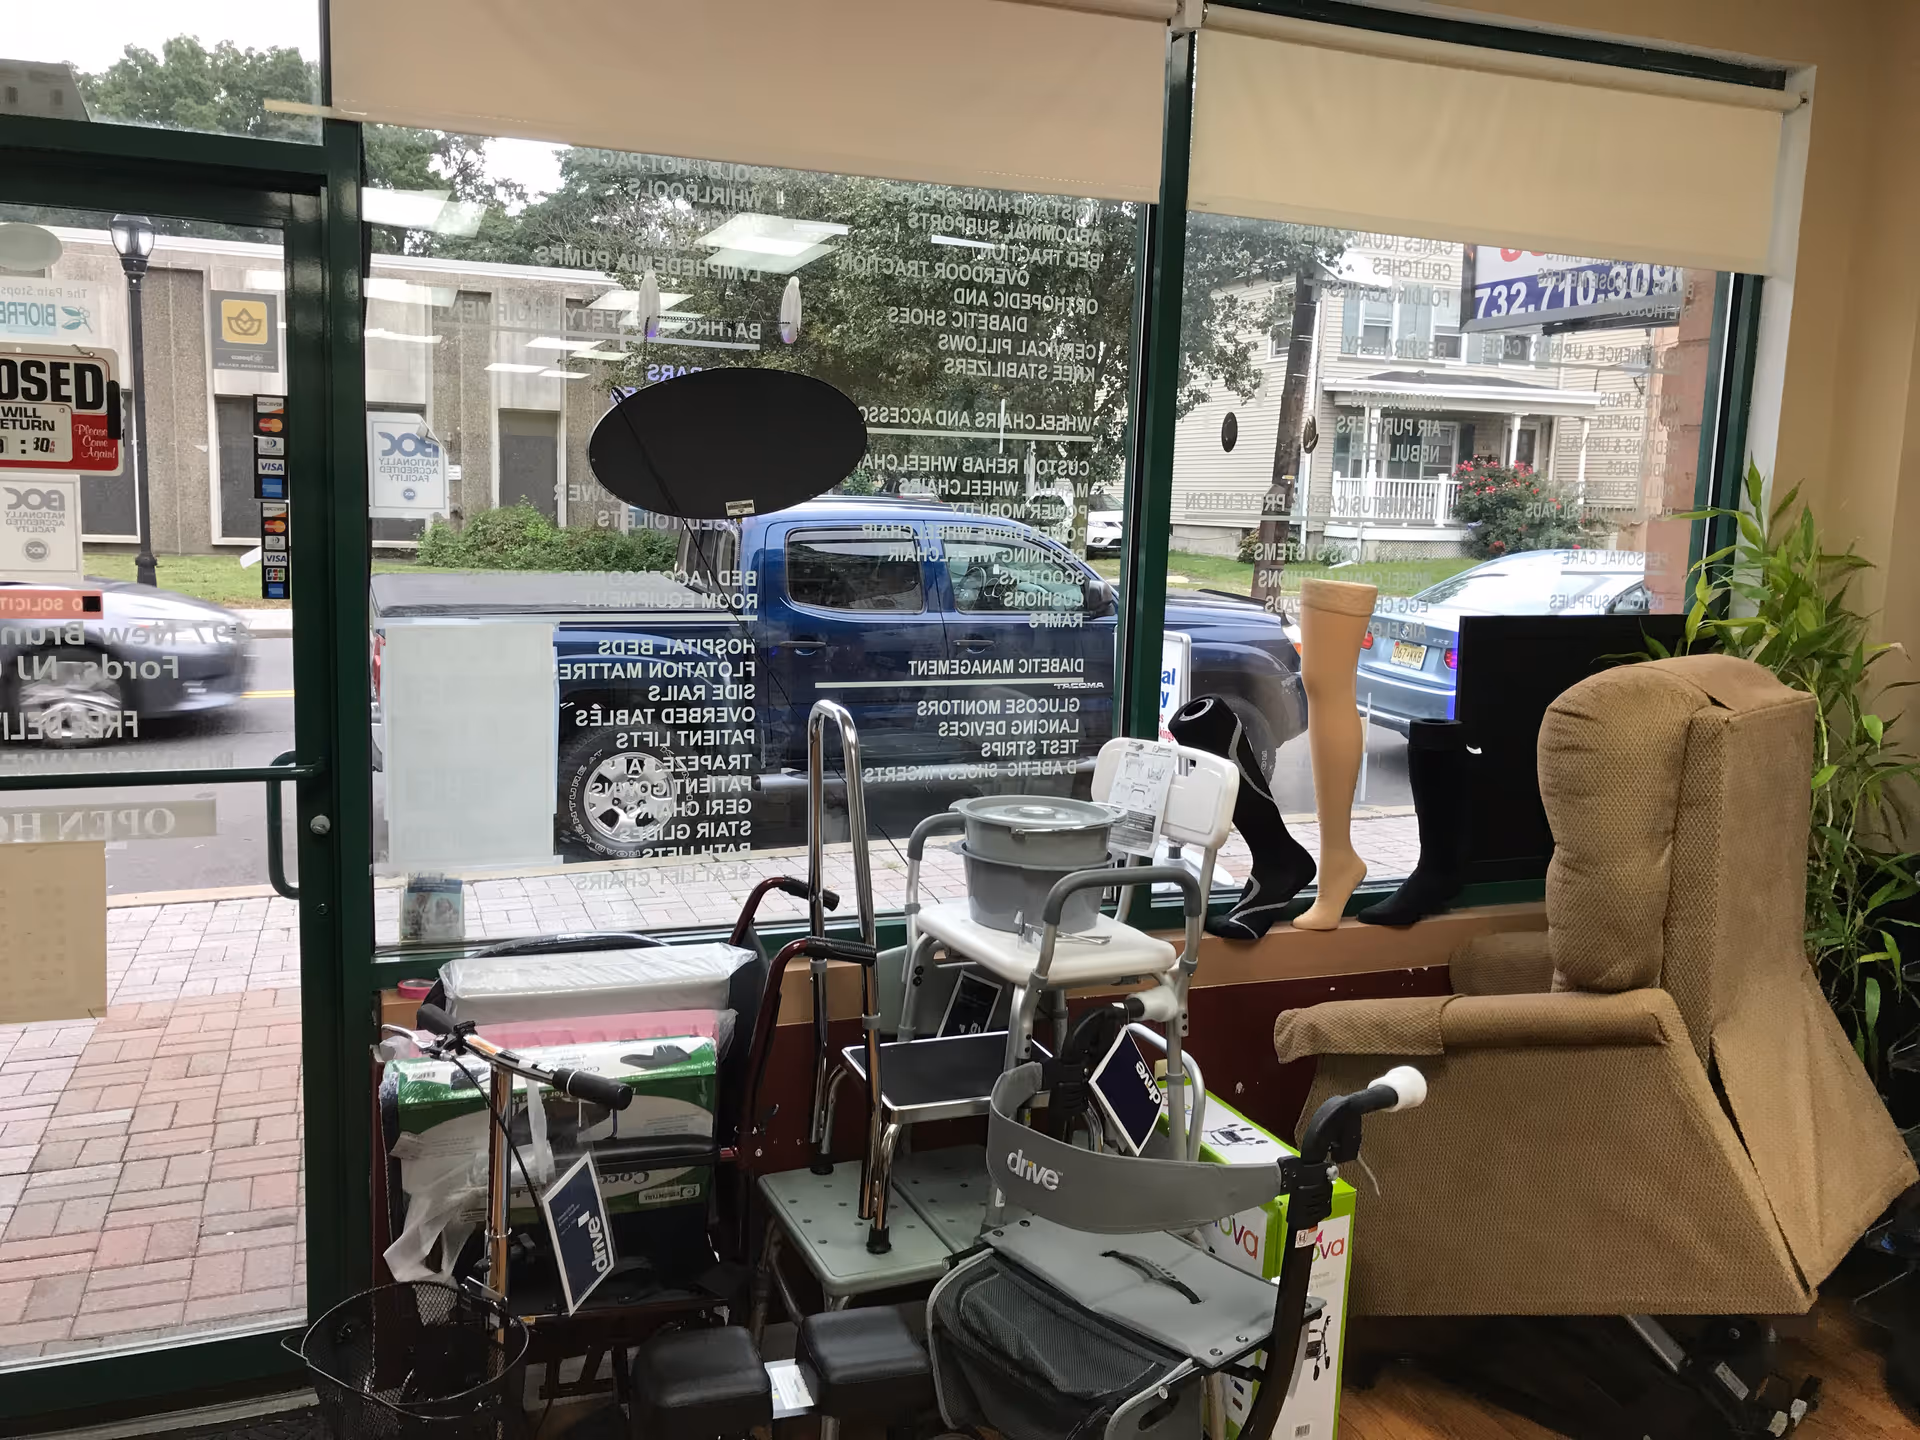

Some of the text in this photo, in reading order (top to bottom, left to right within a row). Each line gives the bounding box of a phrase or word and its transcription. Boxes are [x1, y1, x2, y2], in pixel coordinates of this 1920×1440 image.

[1, 406, 42, 419] WILL
[82, 435, 109, 448] Come
[80, 447, 116, 460] Again!
[261, 462, 284, 471] VISA
[266, 554, 288, 563] VISA
[1053, 682, 1105, 690] TACOMA
[1134, 1060, 1162, 1105] drive
[1006, 1148, 1060, 1191] drive
[1214, 1214, 1259, 1260] ova
[587, 1215, 609, 1273] drive
[1312, 1236, 1346, 1262] ova
